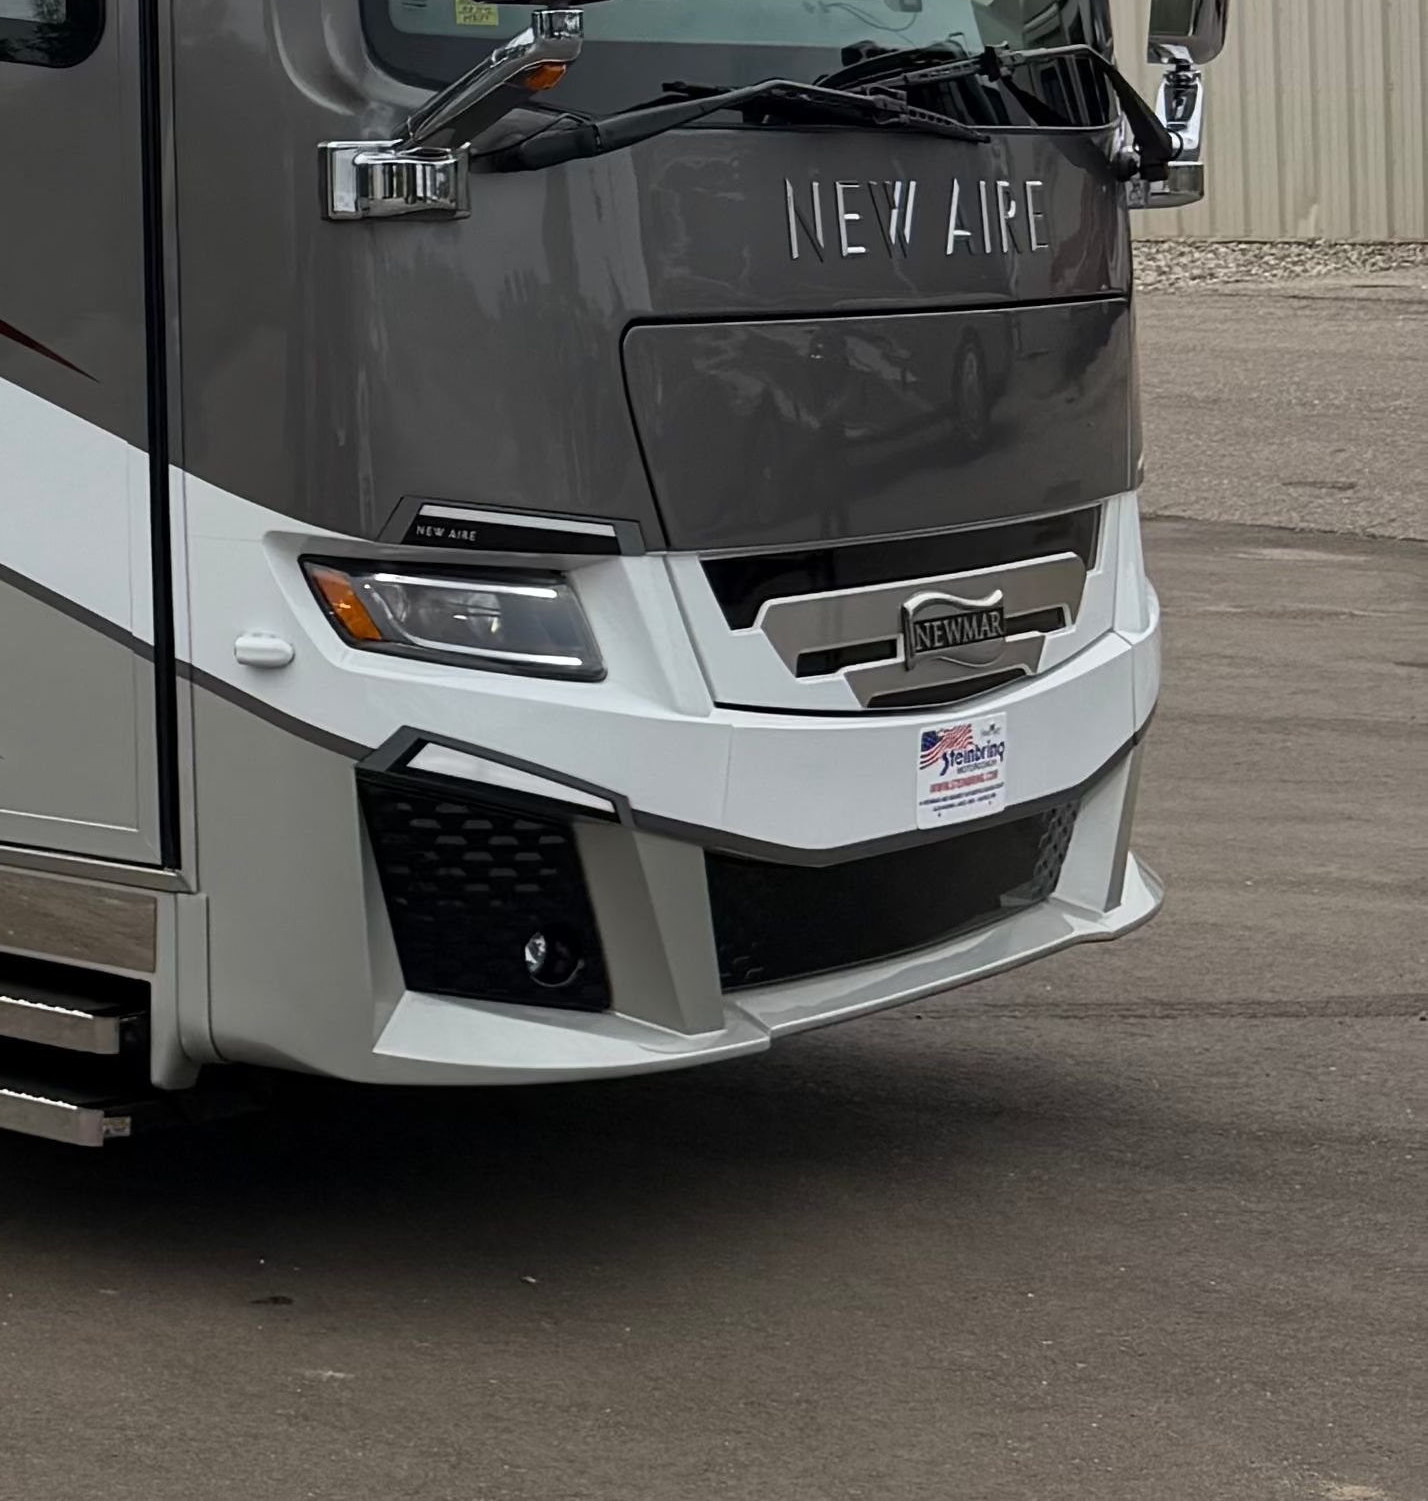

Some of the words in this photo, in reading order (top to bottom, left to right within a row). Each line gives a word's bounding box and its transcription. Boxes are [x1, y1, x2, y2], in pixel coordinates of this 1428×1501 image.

[785, 178, 917, 262] NEW
[946, 178, 1049, 255] AIRE
[416, 525, 445, 538] NEW
[448, 529, 477, 542] AIRE
[915, 611, 1003, 650] NEWMAR
[940, 739, 1005, 776] Steinbring
